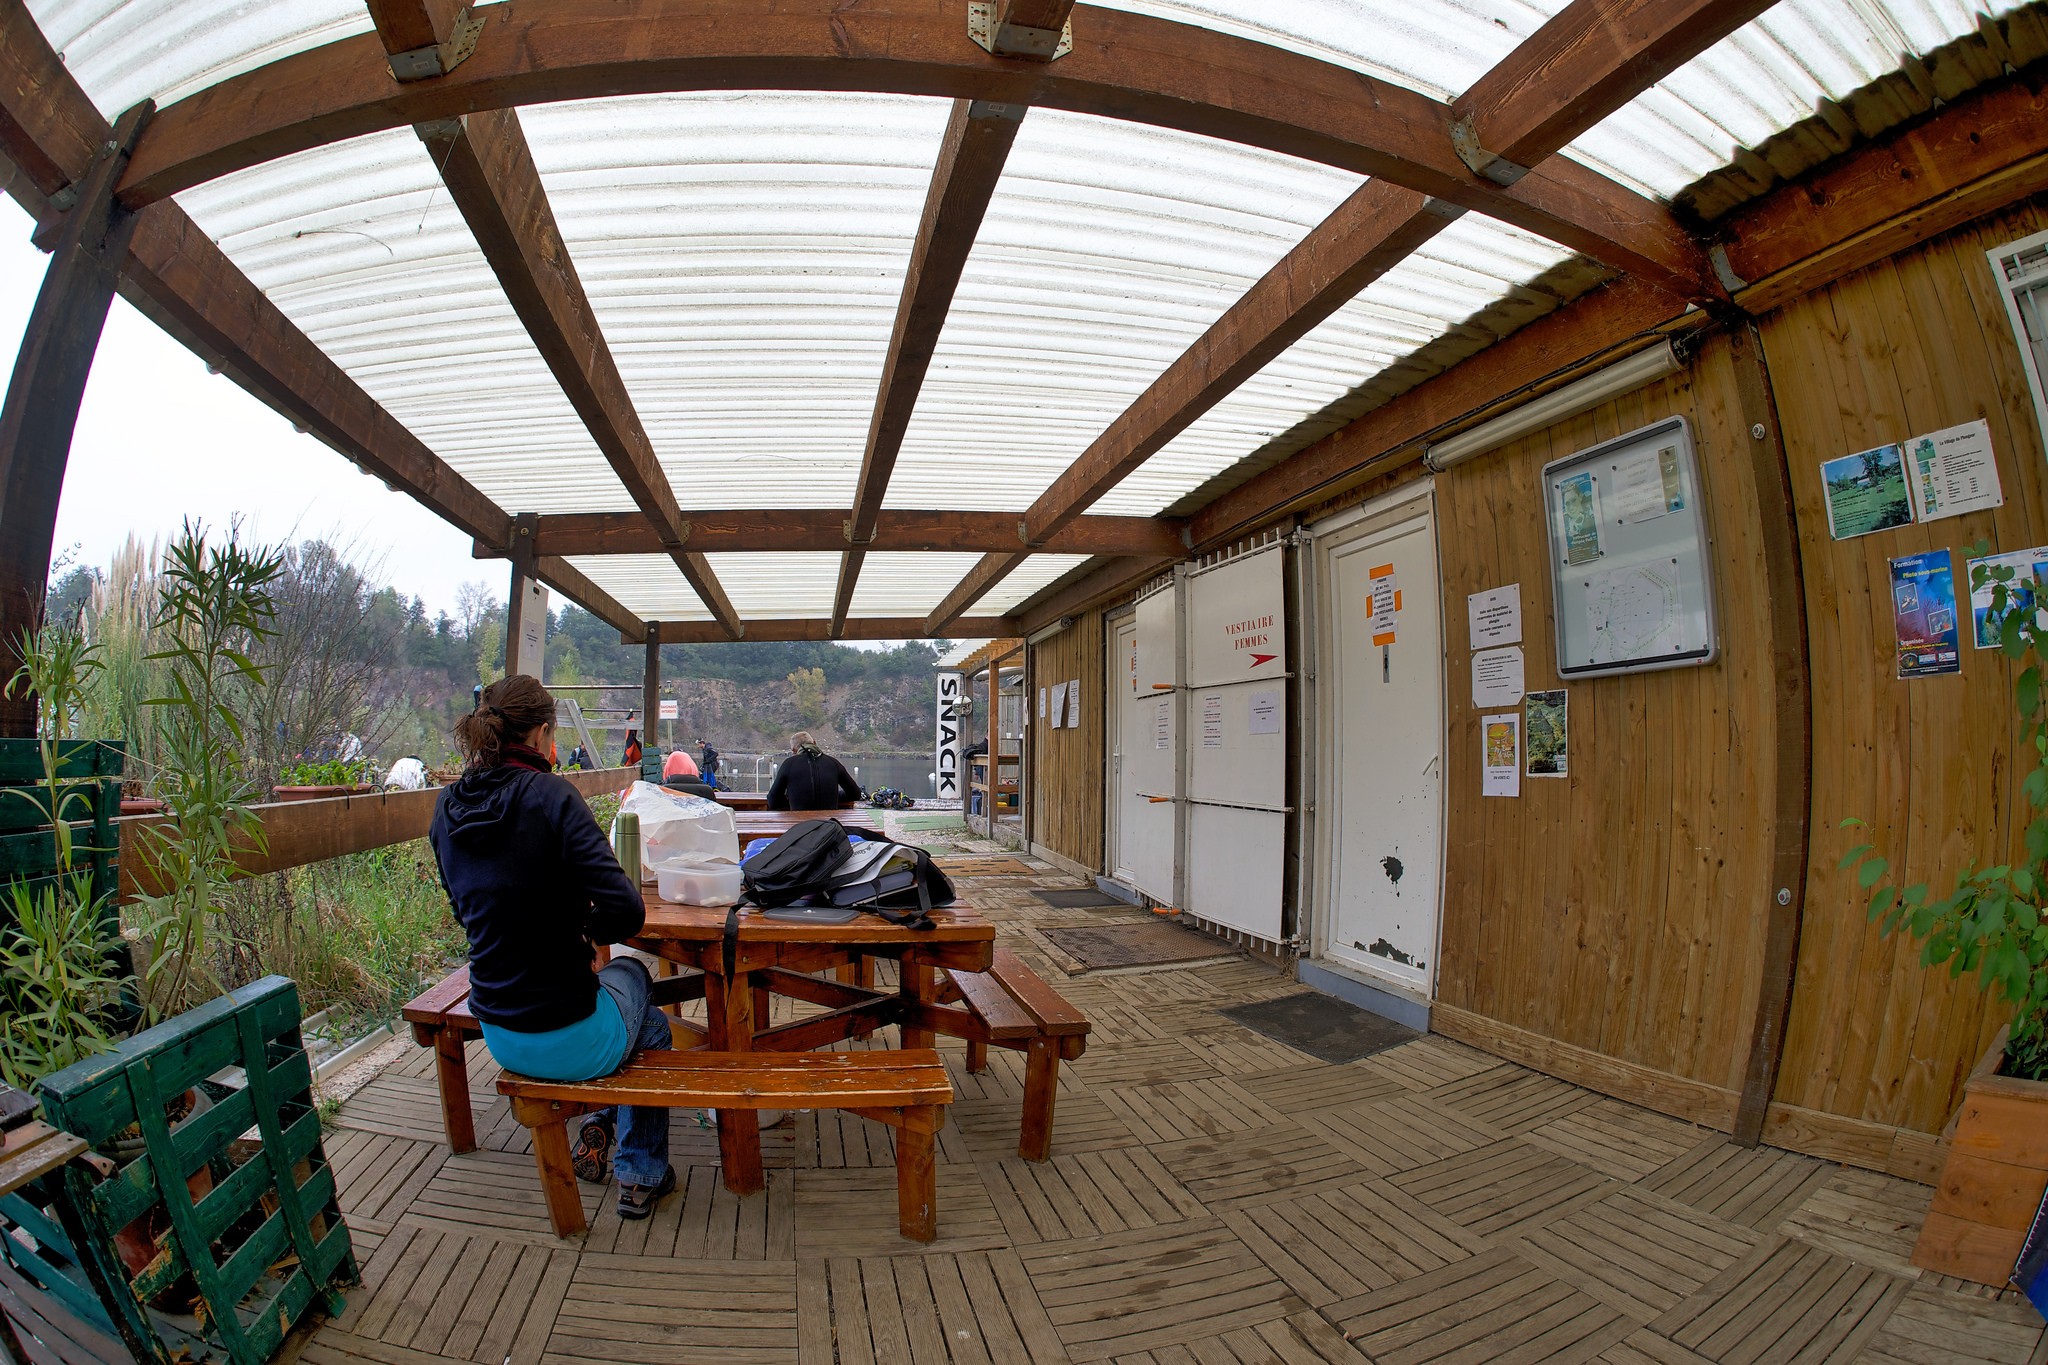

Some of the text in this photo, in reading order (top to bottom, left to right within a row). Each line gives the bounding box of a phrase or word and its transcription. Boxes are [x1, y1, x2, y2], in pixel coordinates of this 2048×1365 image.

[1894, 559, 1922, 568] Formation
[1225, 614, 1274, 635] VESTIAIRE
[1234, 634, 1268, 650] FEMMES
[941, 678, 957, 792] SNACK
